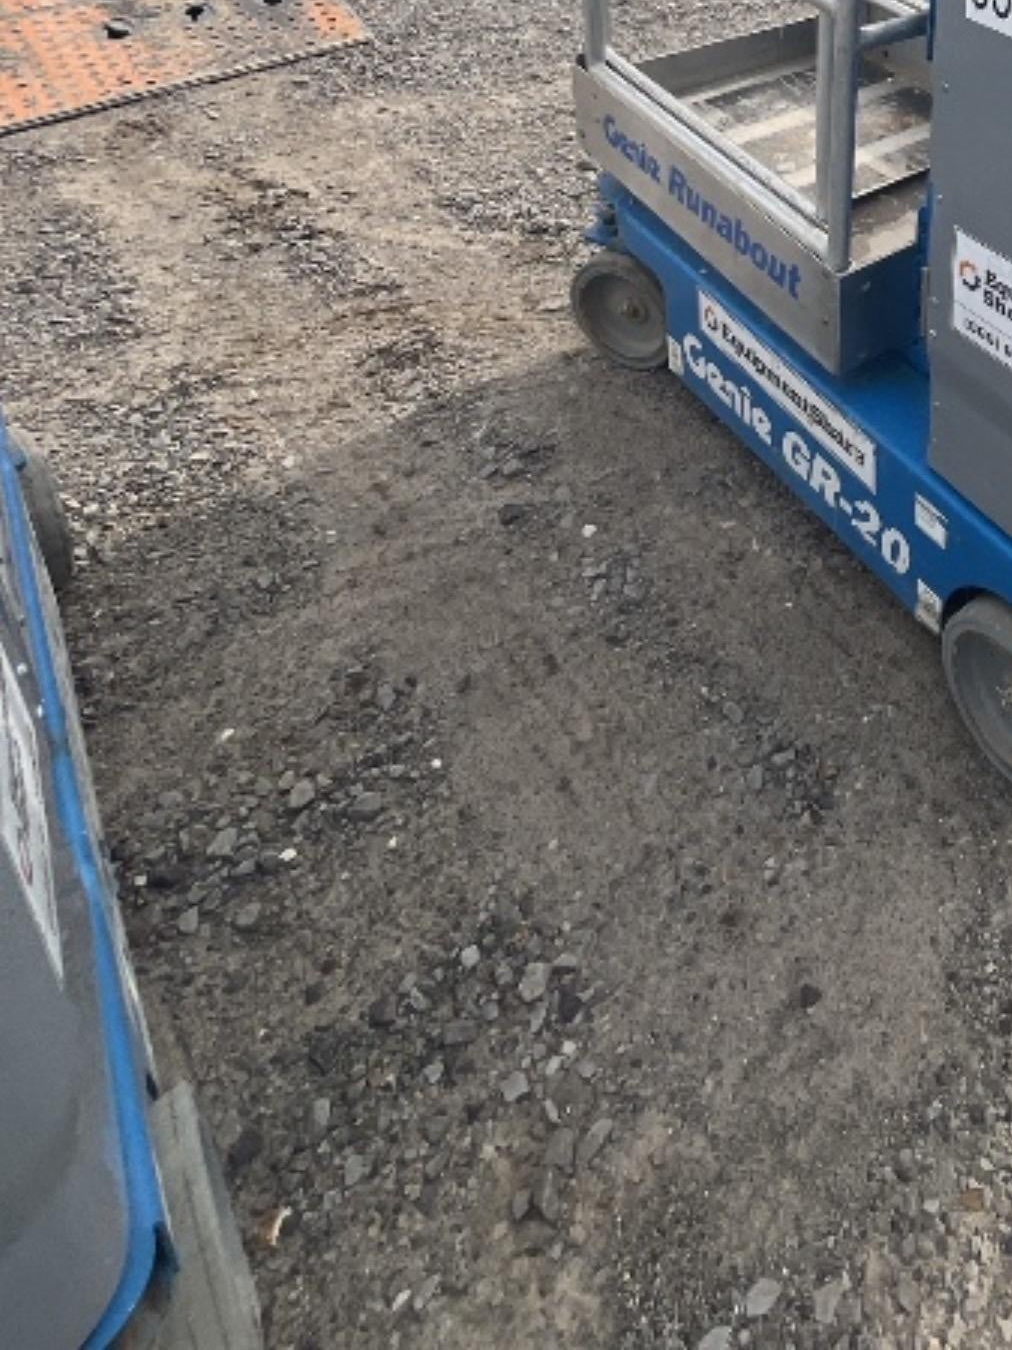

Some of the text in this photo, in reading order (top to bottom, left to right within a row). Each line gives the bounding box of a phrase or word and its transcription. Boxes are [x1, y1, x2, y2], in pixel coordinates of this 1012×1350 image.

[668, 163, 802, 300] Runabout
[682, 332, 911, 574] Genie GR-20
